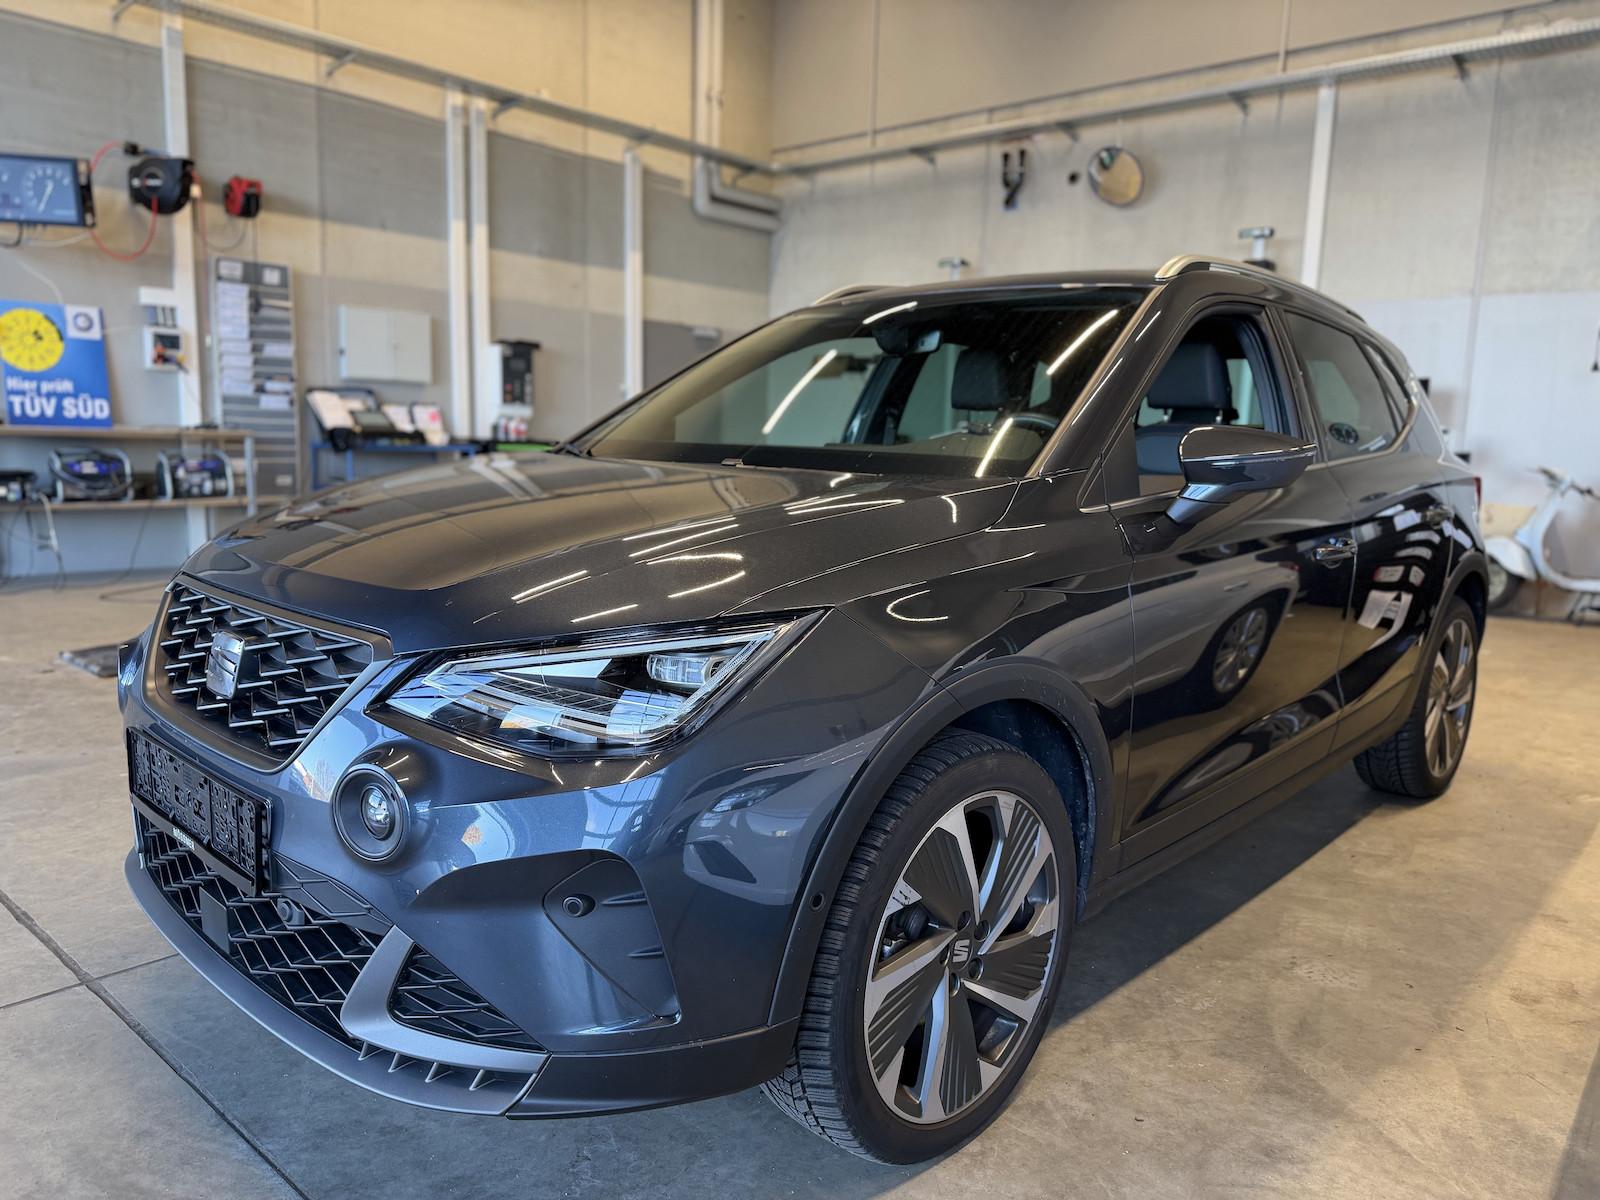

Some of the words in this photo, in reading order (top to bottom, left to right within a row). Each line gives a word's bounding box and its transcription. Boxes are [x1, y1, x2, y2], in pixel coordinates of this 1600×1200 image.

[6, 377, 37, 391] Hier
[9, 392, 57, 418] TÜV
[62, 393, 110, 419] SÜD
